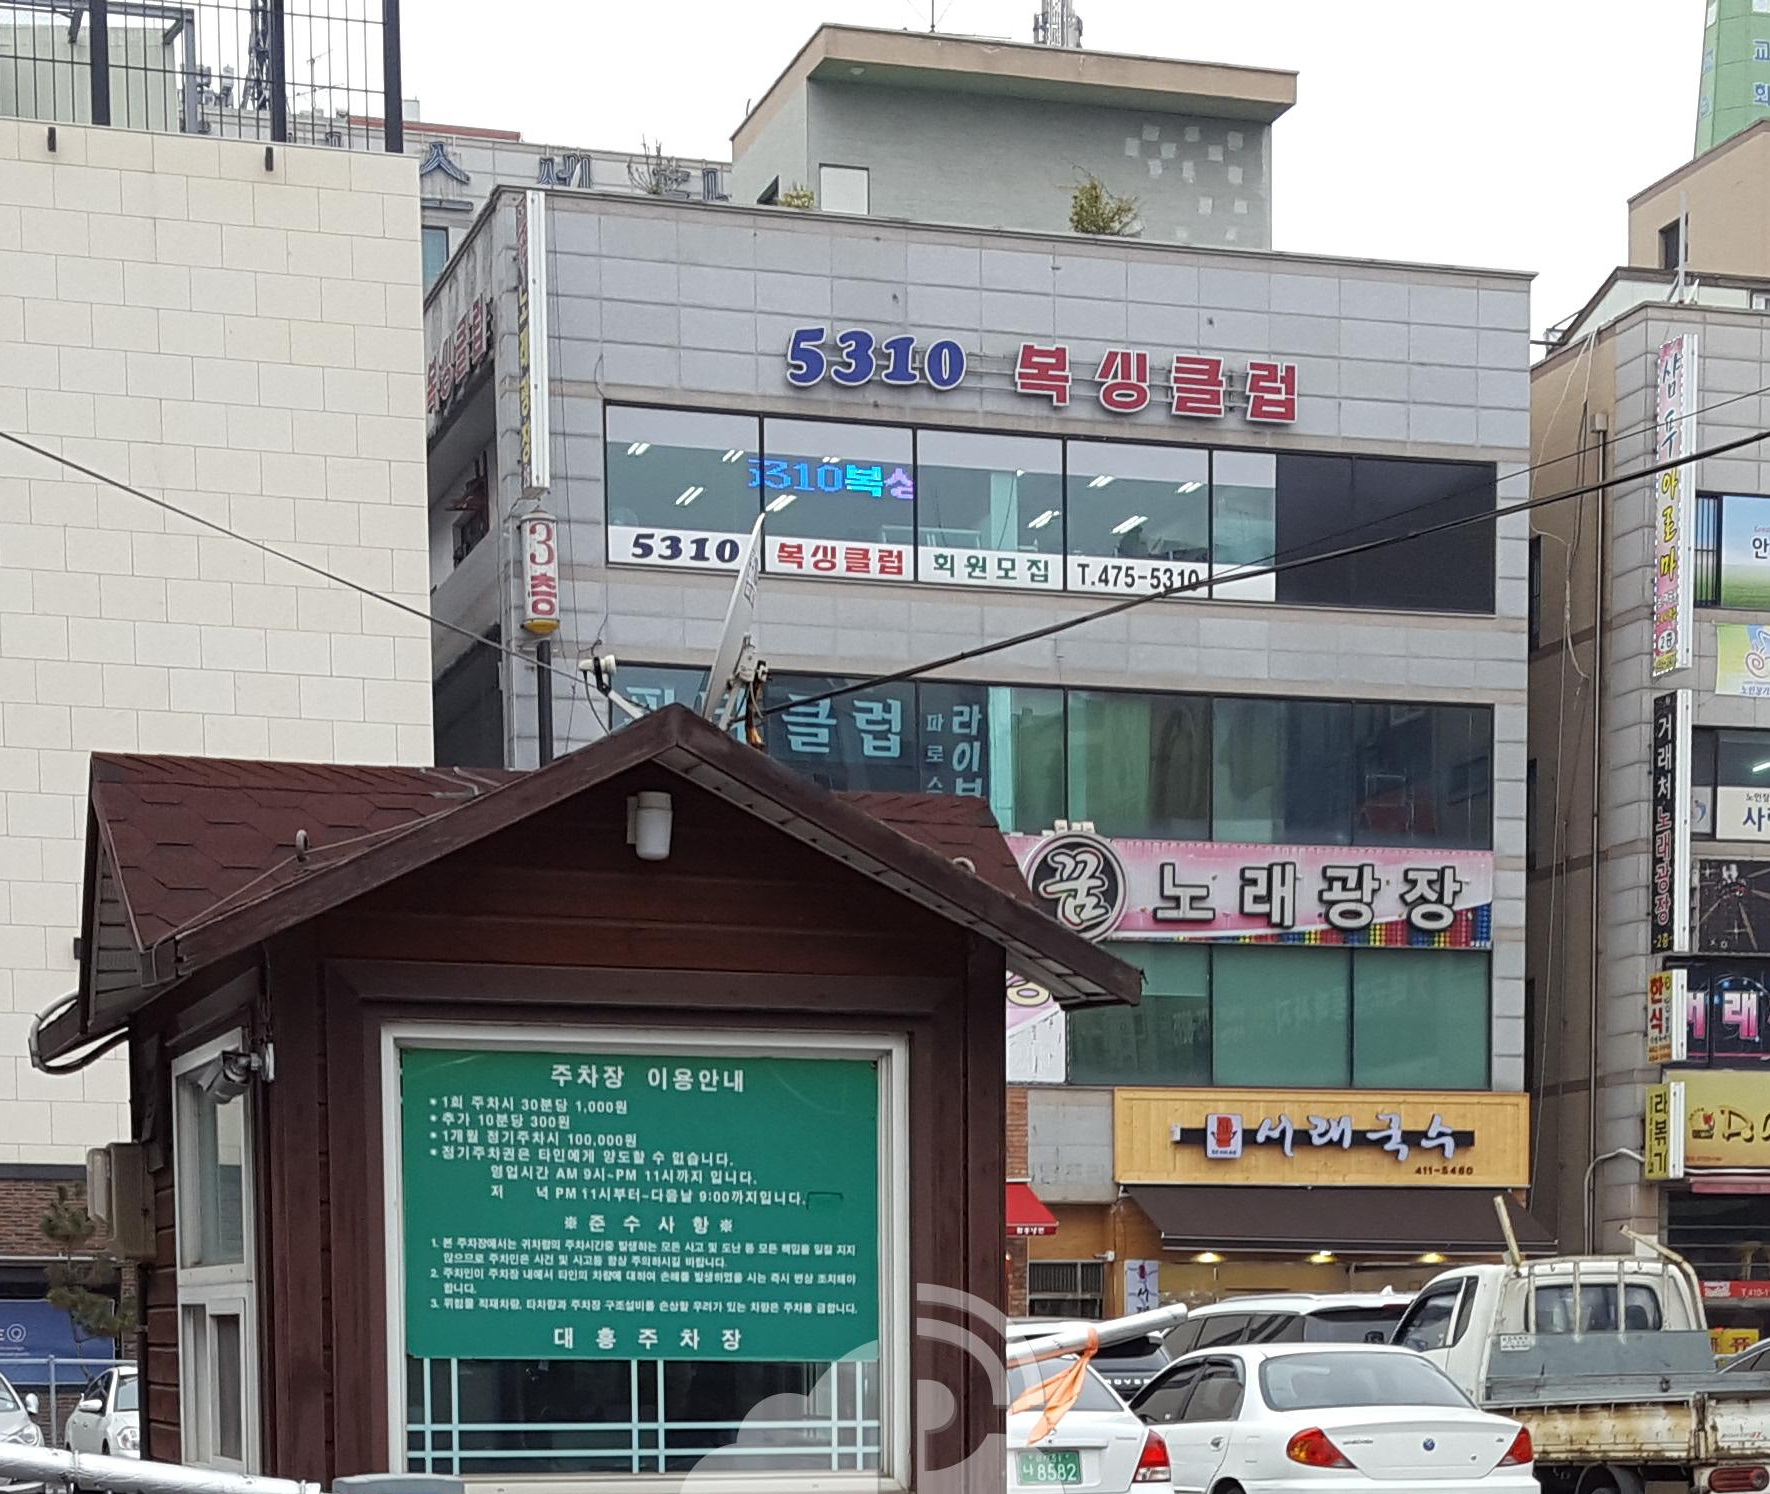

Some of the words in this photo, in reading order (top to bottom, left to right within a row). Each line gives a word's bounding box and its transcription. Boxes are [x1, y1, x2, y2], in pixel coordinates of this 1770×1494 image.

[787, 325, 966, 390] 5310
[1014, 341, 1298, 423] 복싱클럽
[529, 522, 557, 616] 3층
[631, 532, 740, 564] 5310
[777, 541, 904, 576] 복싱클럽
[932, 553, 1050, 585] 회원모집
[1078, 562, 1201, 594] T.475-5310
[1657, 713, 1673, 800] 거래처
[1653, 805, 1672, 926] 노래광장
[1153, 862, 1464, 932] 노래광장
[551, 1064, 624, 1088] 주차장
[647, 1067, 744, 1092] 이용안내
[442, 1096, 463, 1109] 1회
[471, 1096, 514, 1111] 주차시
[521, 1098, 568, 1112] 30분당
[576, 1100, 627, 1114] 1,000원
[442, 1112, 470, 1127] 추가
[479, 1114, 523, 1128] 10분당
[530, 1115, 570, 1129] 300원
[442, 1129, 479, 1143] 1개월
[487, 1131, 560, 1145] 정기주차시
[568, 1133, 637, 1148] 100,000원
[1254, 1111, 1458, 1162] 서래국수
[538, 1148, 595, 1163] 타인에게
[652, 1151, 665, 1165] 수
[672, 1152, 734, 1167] 없습니다.
[491, 1165, 549, 1180] 영업시간
[555, 1168, 577, 1180] AM
[645, 1169, 703, 1184] 11시까지
[710, 1170, 757, 1185] 입니다.
[555, 1187, 576, 1200] PM
[1037, 1464, 1077, 1481] 8582
